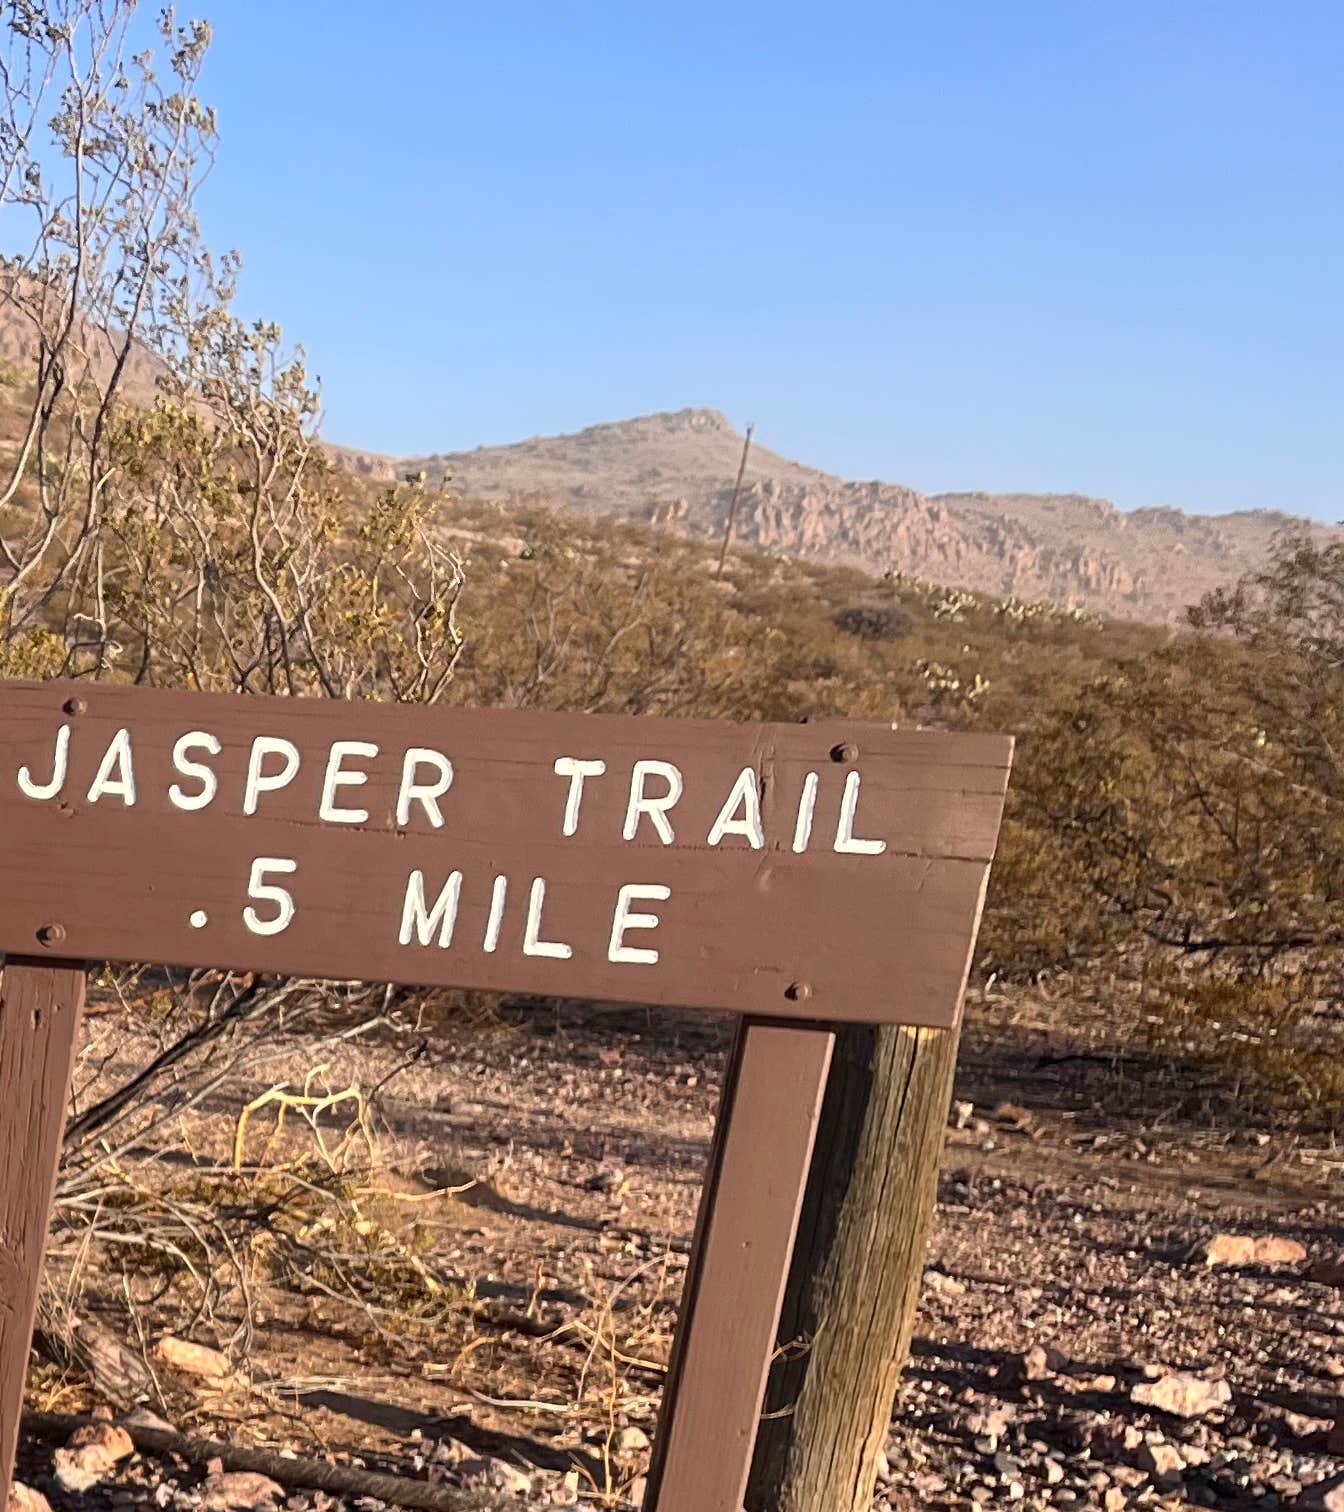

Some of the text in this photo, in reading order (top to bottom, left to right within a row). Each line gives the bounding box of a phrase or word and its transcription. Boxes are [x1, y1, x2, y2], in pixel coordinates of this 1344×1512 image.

[16, 723, 889, 856] JASPER TRAIL
[187, 856, 673, 966] .5 MILE
